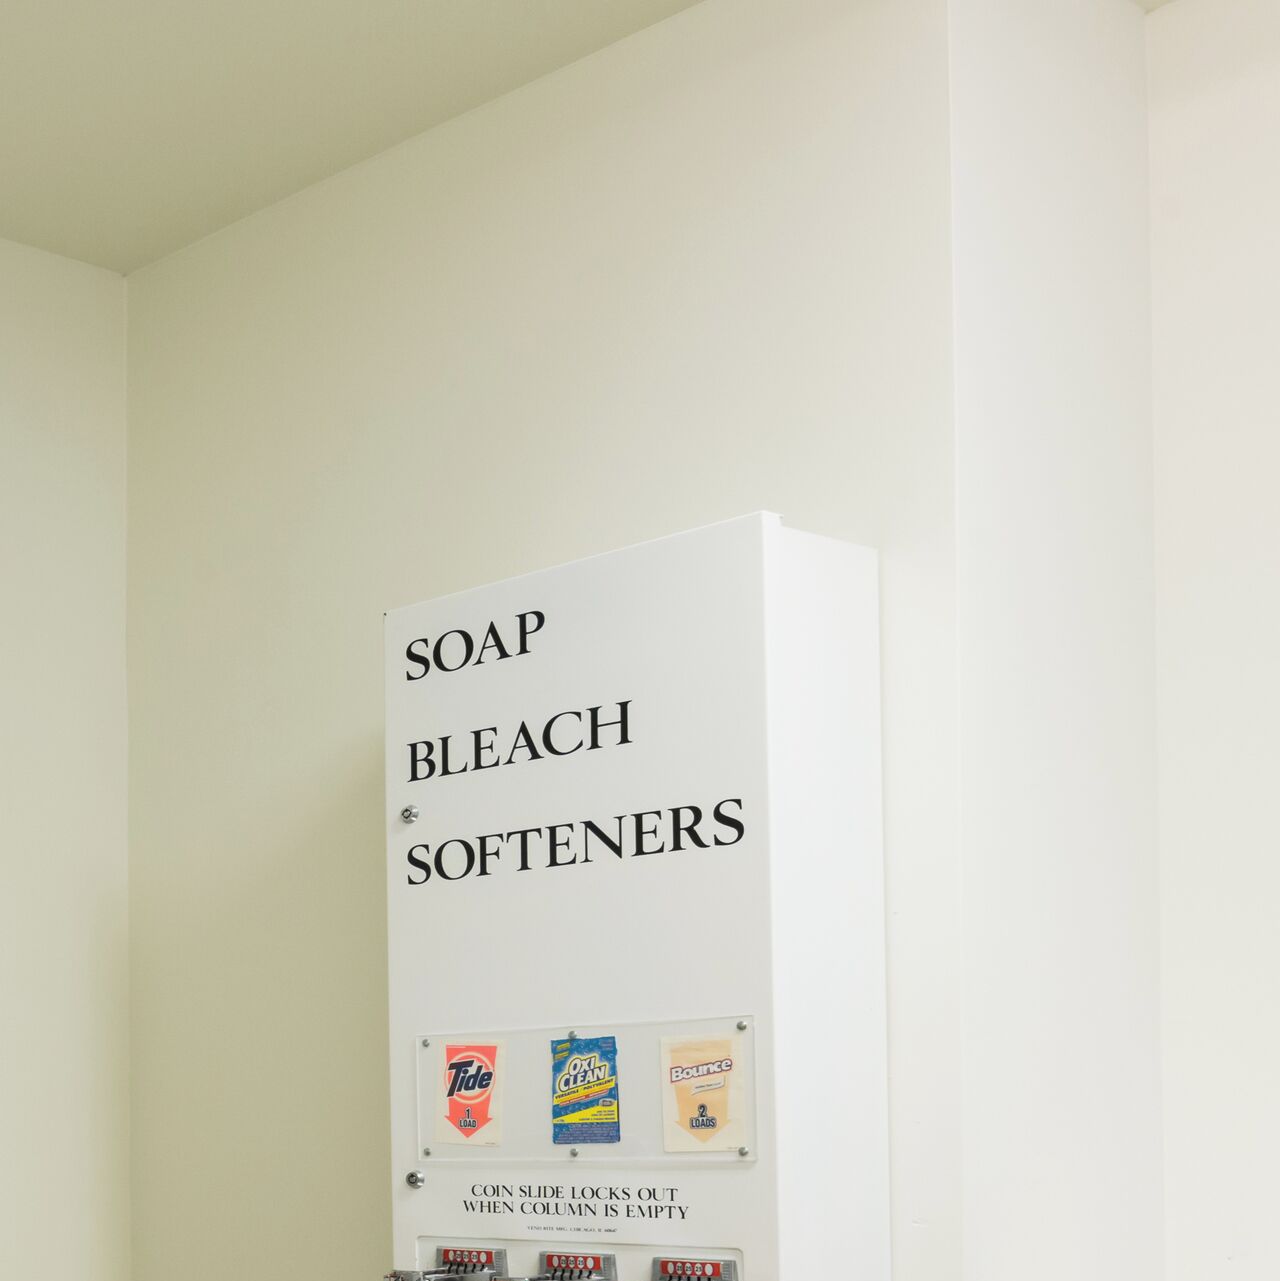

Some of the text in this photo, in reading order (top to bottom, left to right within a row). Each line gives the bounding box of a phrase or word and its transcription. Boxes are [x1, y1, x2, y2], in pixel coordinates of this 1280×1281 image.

[405, 610, 546, 681] SOAP
[406, 699, 633, 784] BLEACH
[405, 798, 745, 885] SOFTENERS
[568, 1055, 597, 1076] OXI
[670, 1058, 733, 1084] Bounce
[446, 1059, 494, 1098] Tide
[558, 1064, 607, 1092] CLEAN
[465, 1107, 472, 1119] 1
[698, 1104, 707, 1118] 2
[459, 1119, 477, 1128] LOAD
[690, 1117, 717, 1129] LOADS
[471, 1183, 678, 1202] COIN SLIDE LOCKS OUT
[463, 1199, 689, 1220] WHEN COLUMN IS EMPTY
